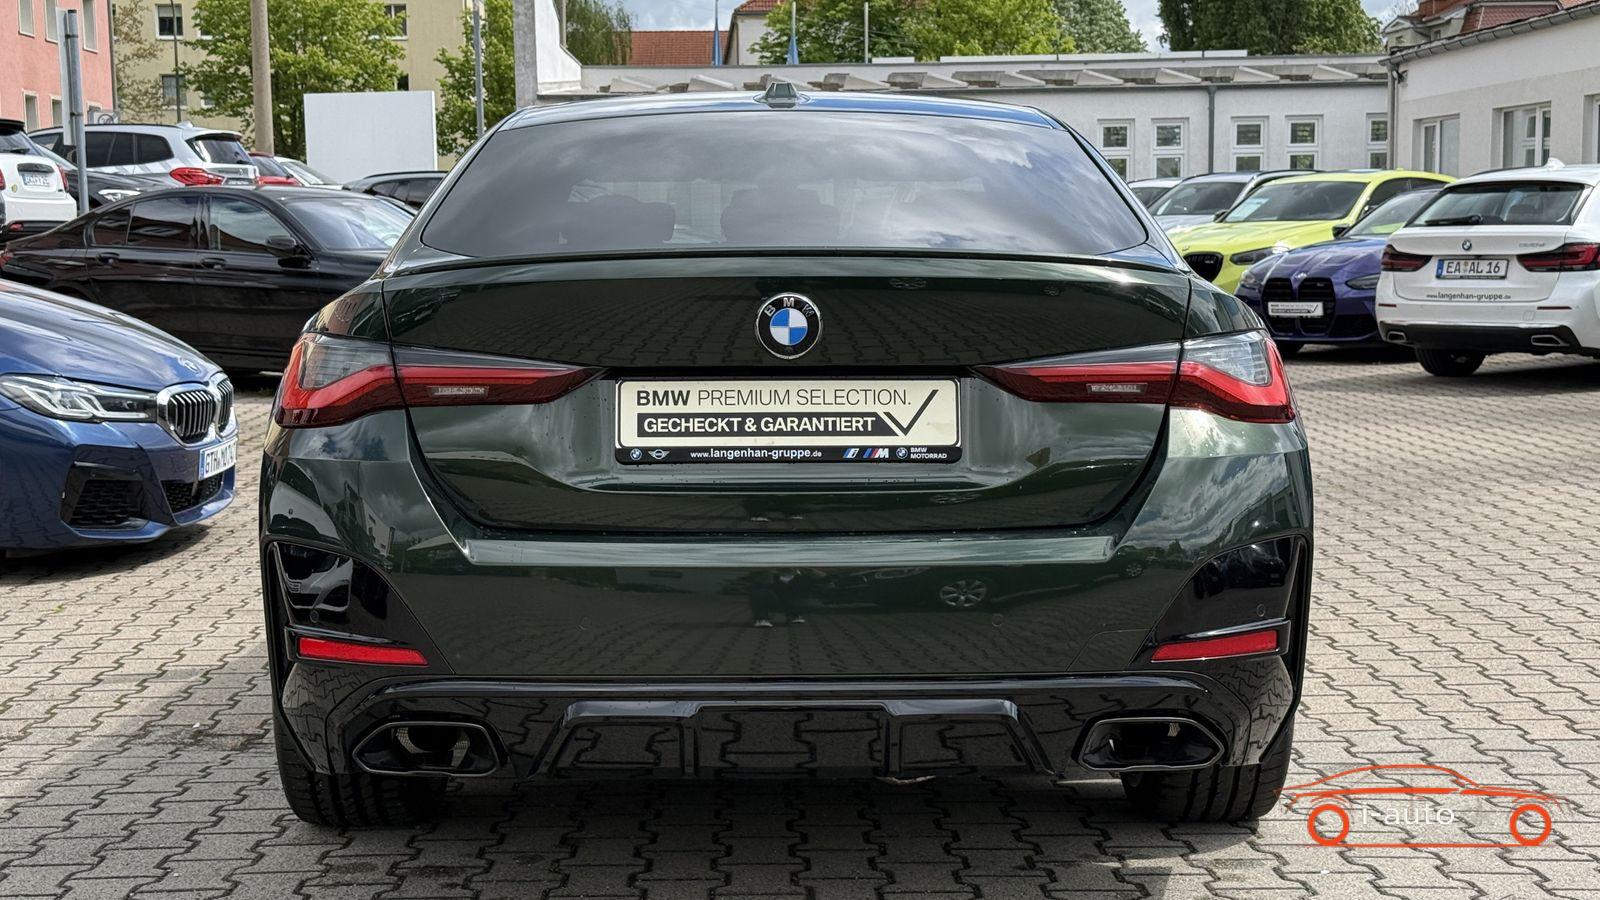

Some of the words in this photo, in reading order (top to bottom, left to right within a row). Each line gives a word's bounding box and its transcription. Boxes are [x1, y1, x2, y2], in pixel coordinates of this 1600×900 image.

[1446, 261, 1461, 274] EA
[1469, 261, 1484, 274] AL
[1485, 261, 1501, 274] 16
[1426, 291, 1511, 301] www.langenhan-gruppe.de
[764, 297, 815, 318] BMW
[636, 389, 691, 407] BMW
[698, 389, 791, 406] PREMIUM
[796, 388, 912, 406] SELECTION.
[643, 417, 742, 433] GECHECKT
[745, 417, 758, 432] &
[760, 416, 876, 432] GARANTIERT
[690, 448, 822, 460] www.langenhan-gruppe.de
